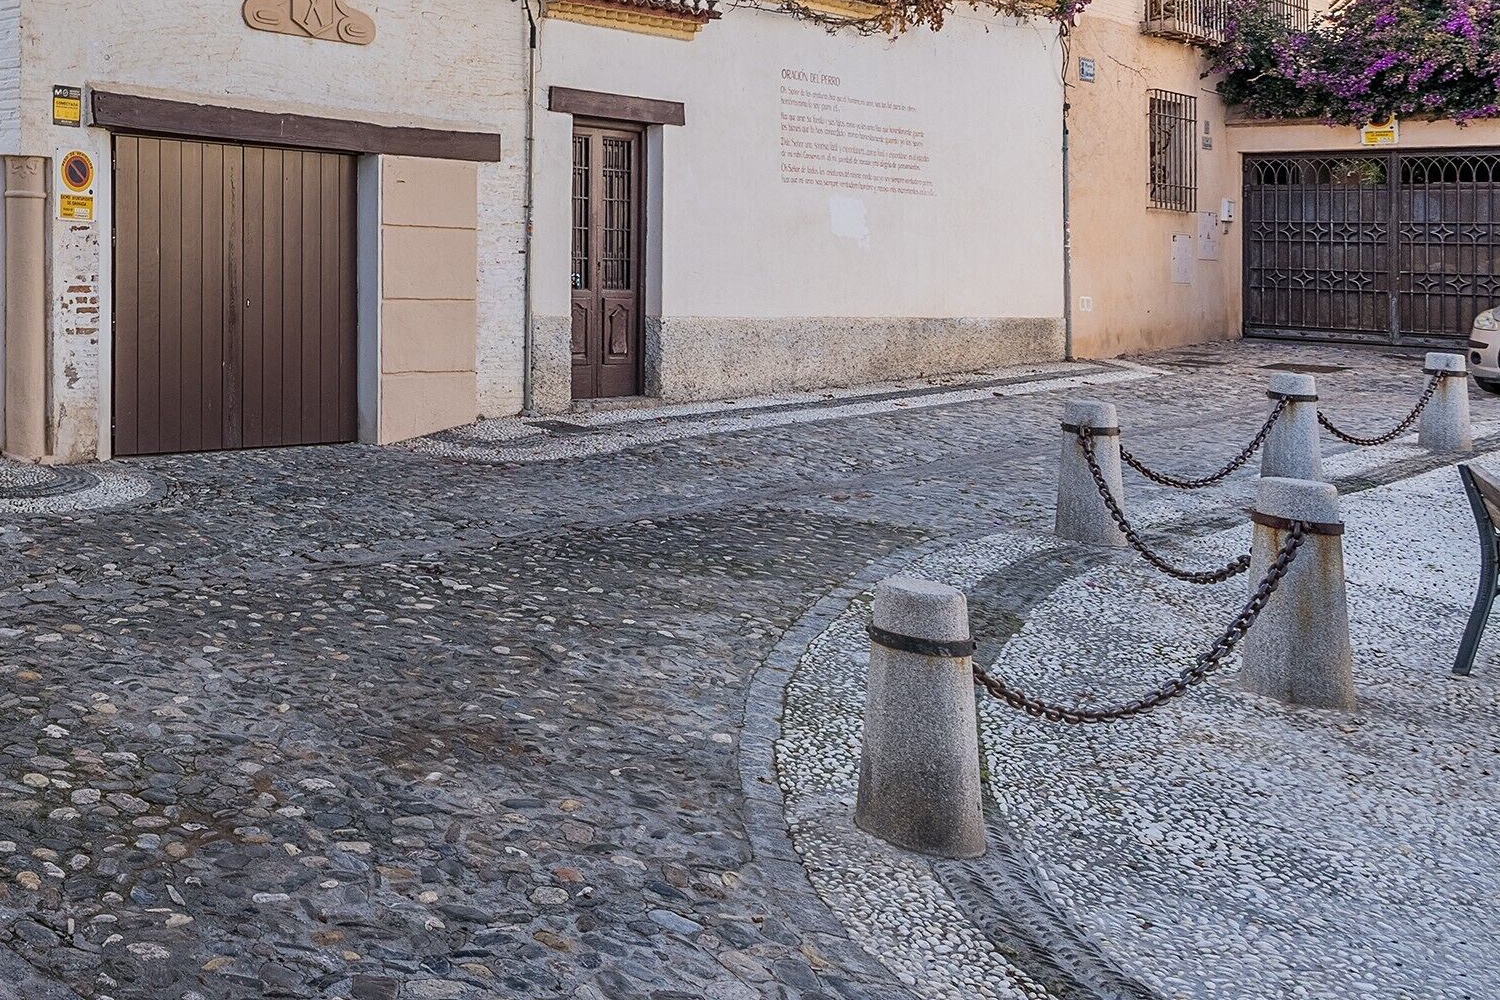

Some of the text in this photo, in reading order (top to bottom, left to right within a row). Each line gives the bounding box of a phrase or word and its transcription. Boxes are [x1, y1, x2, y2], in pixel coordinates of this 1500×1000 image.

[781, 68, 841, 87] ORACIÓN DEL PERRO
